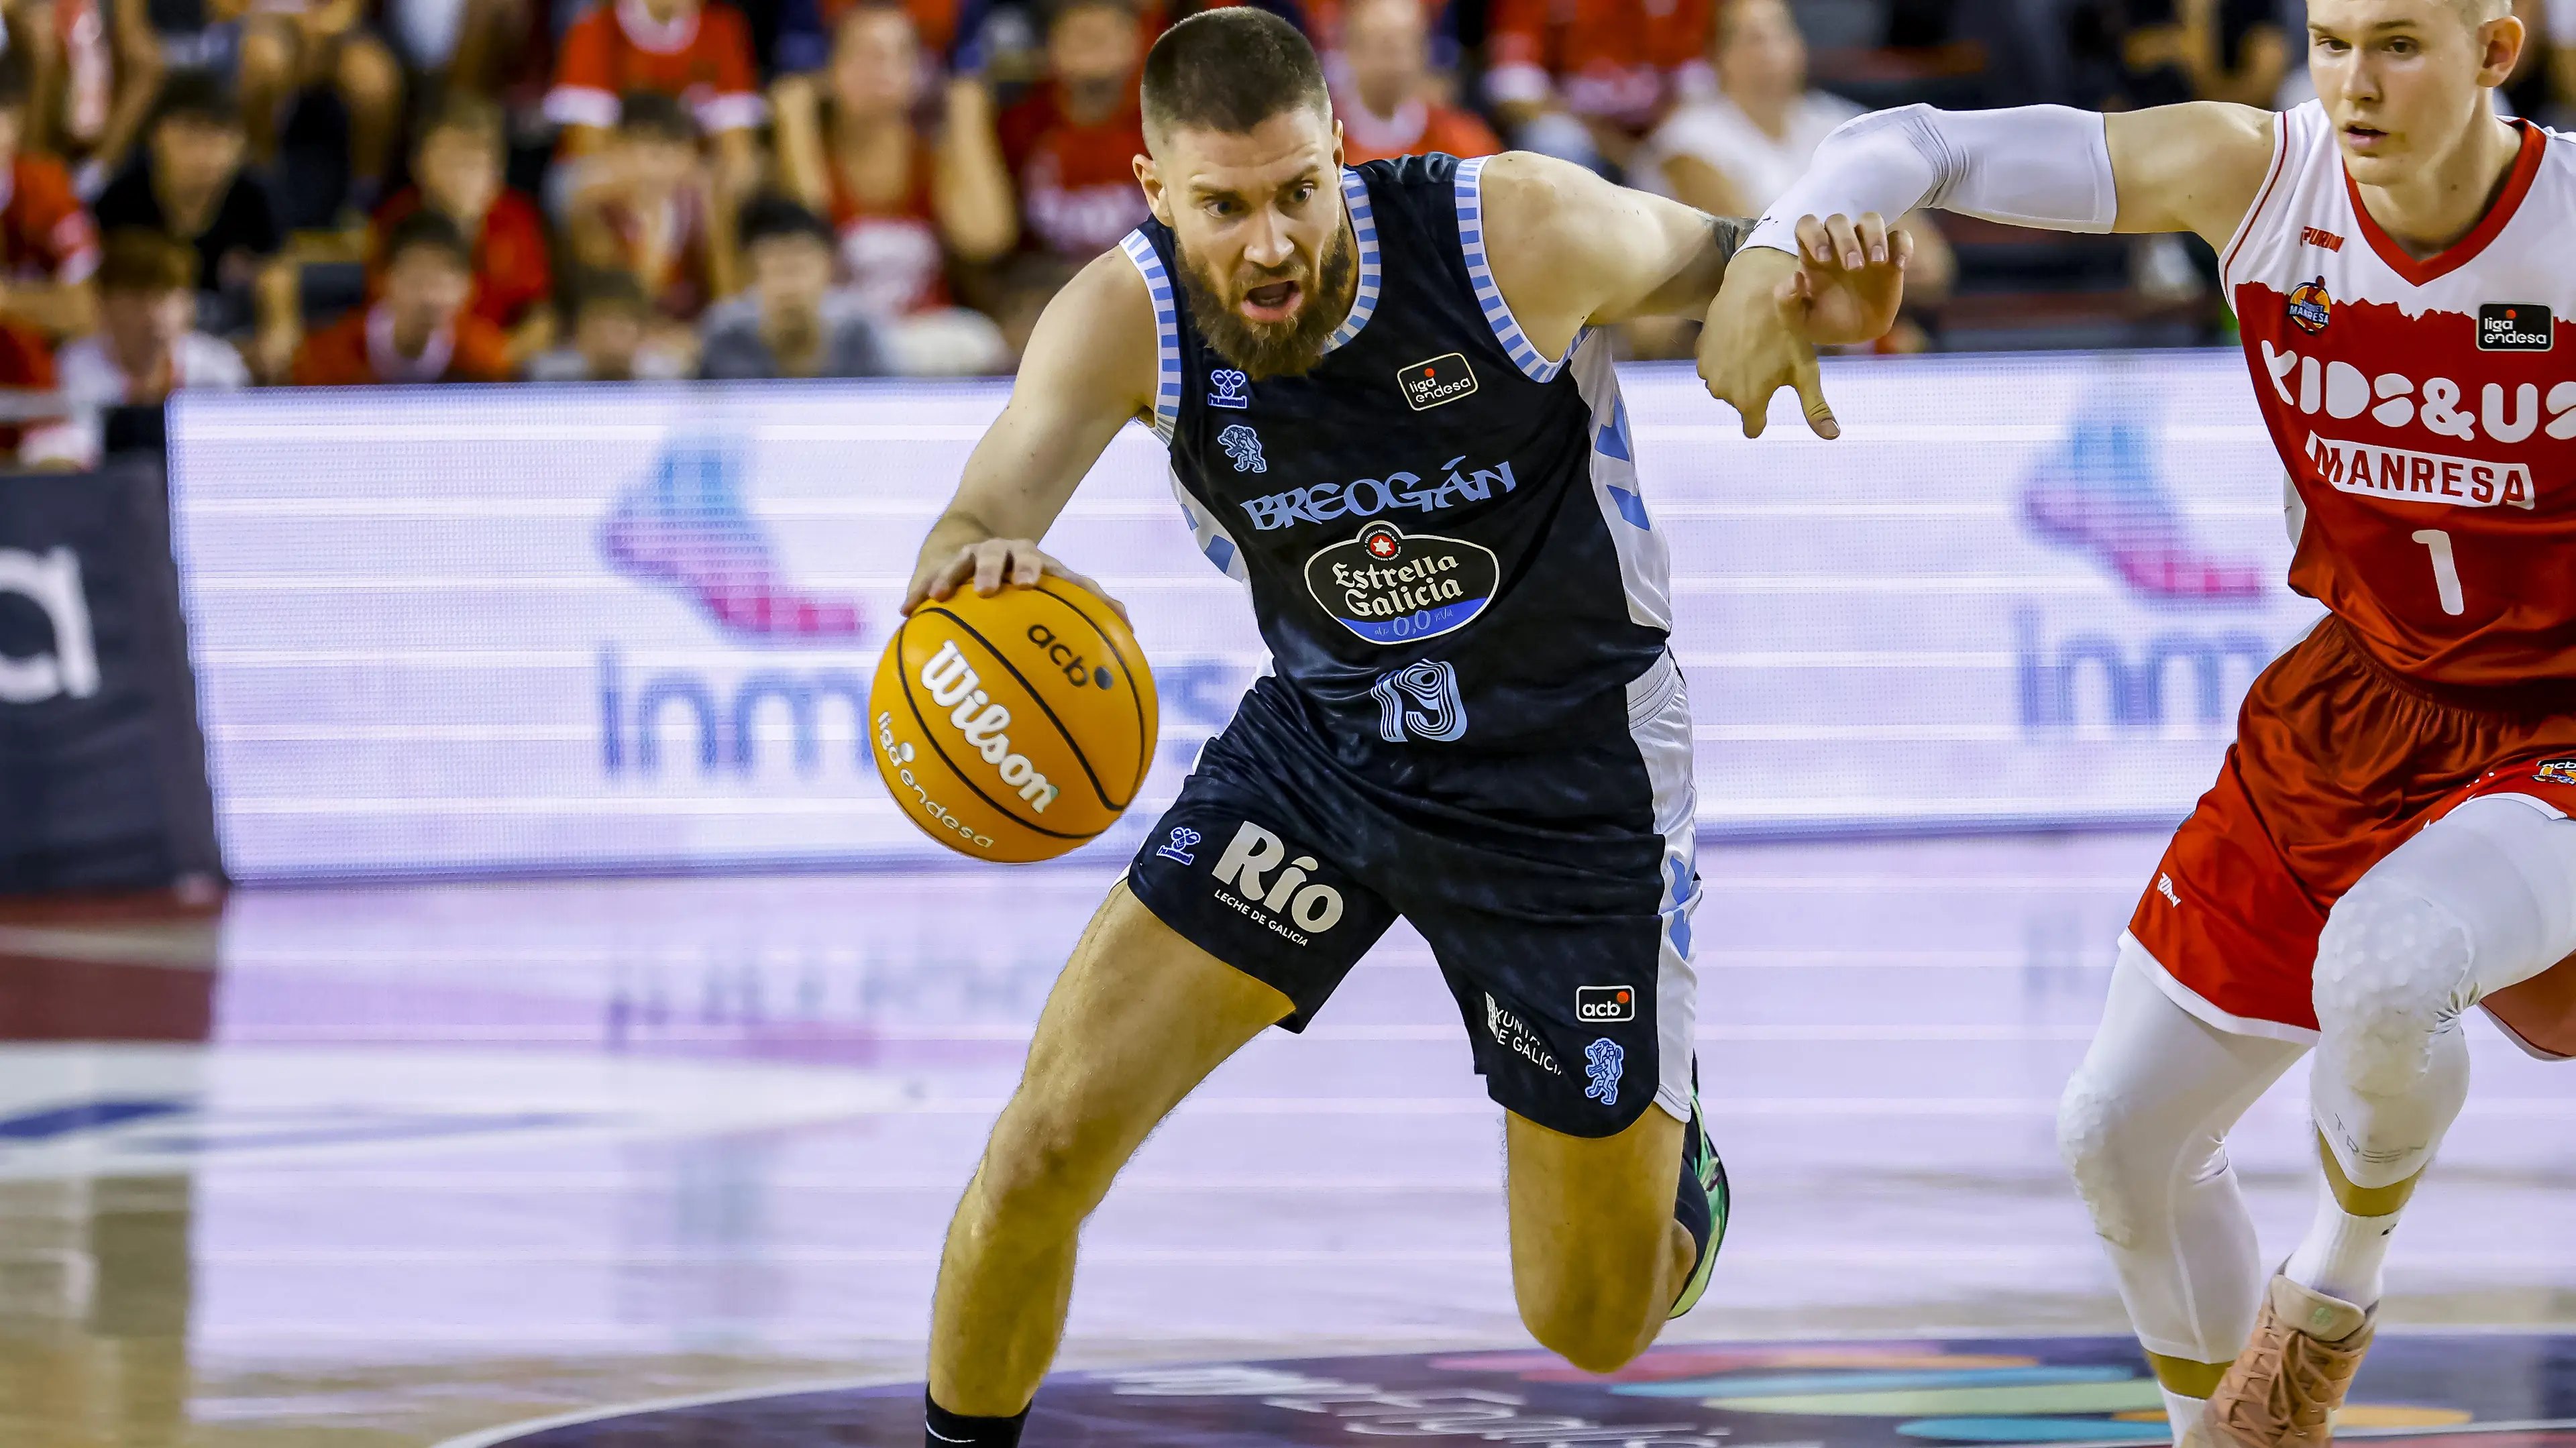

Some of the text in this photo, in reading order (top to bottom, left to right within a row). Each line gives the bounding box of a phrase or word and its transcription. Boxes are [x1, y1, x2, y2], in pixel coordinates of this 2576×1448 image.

[2289, 304, 2329, 325] MANRESA
[2484, 317, 2514, 332] liga
[2484, 331, 2547, 345] endesa
[1409, 377, 1437, 394] liga
[1415, 377, 1471, 403] endesa
[2261, 340, 2576, 443] KIDS&US
[1240, 455, 1516, 530] BREOGÁN
[2314, 439, 2526, 504] MANRESA
[1332, 554, 1459, 590] Estrella
[1344, 577, 1464, 617] Galicia
[2412, 529, 2465, 616] 1
[1393, 609, 1431, 636] 0,0
[1027, 624, 1088, 688] acb
[921, 639, 1059, 814] Wilson
[1371, 659, 1468, 742] 19
[877, 711, 904, 767] liga
[900, 769, 994, 848] endesa
[1212, 821, 1343, 933] Río
[1214, 889, 1308, 946] LECHE DE GALICIA
[1495, 1007, 1540, 1046] XUN
[1582, 1001, 1621, 1017] acb
